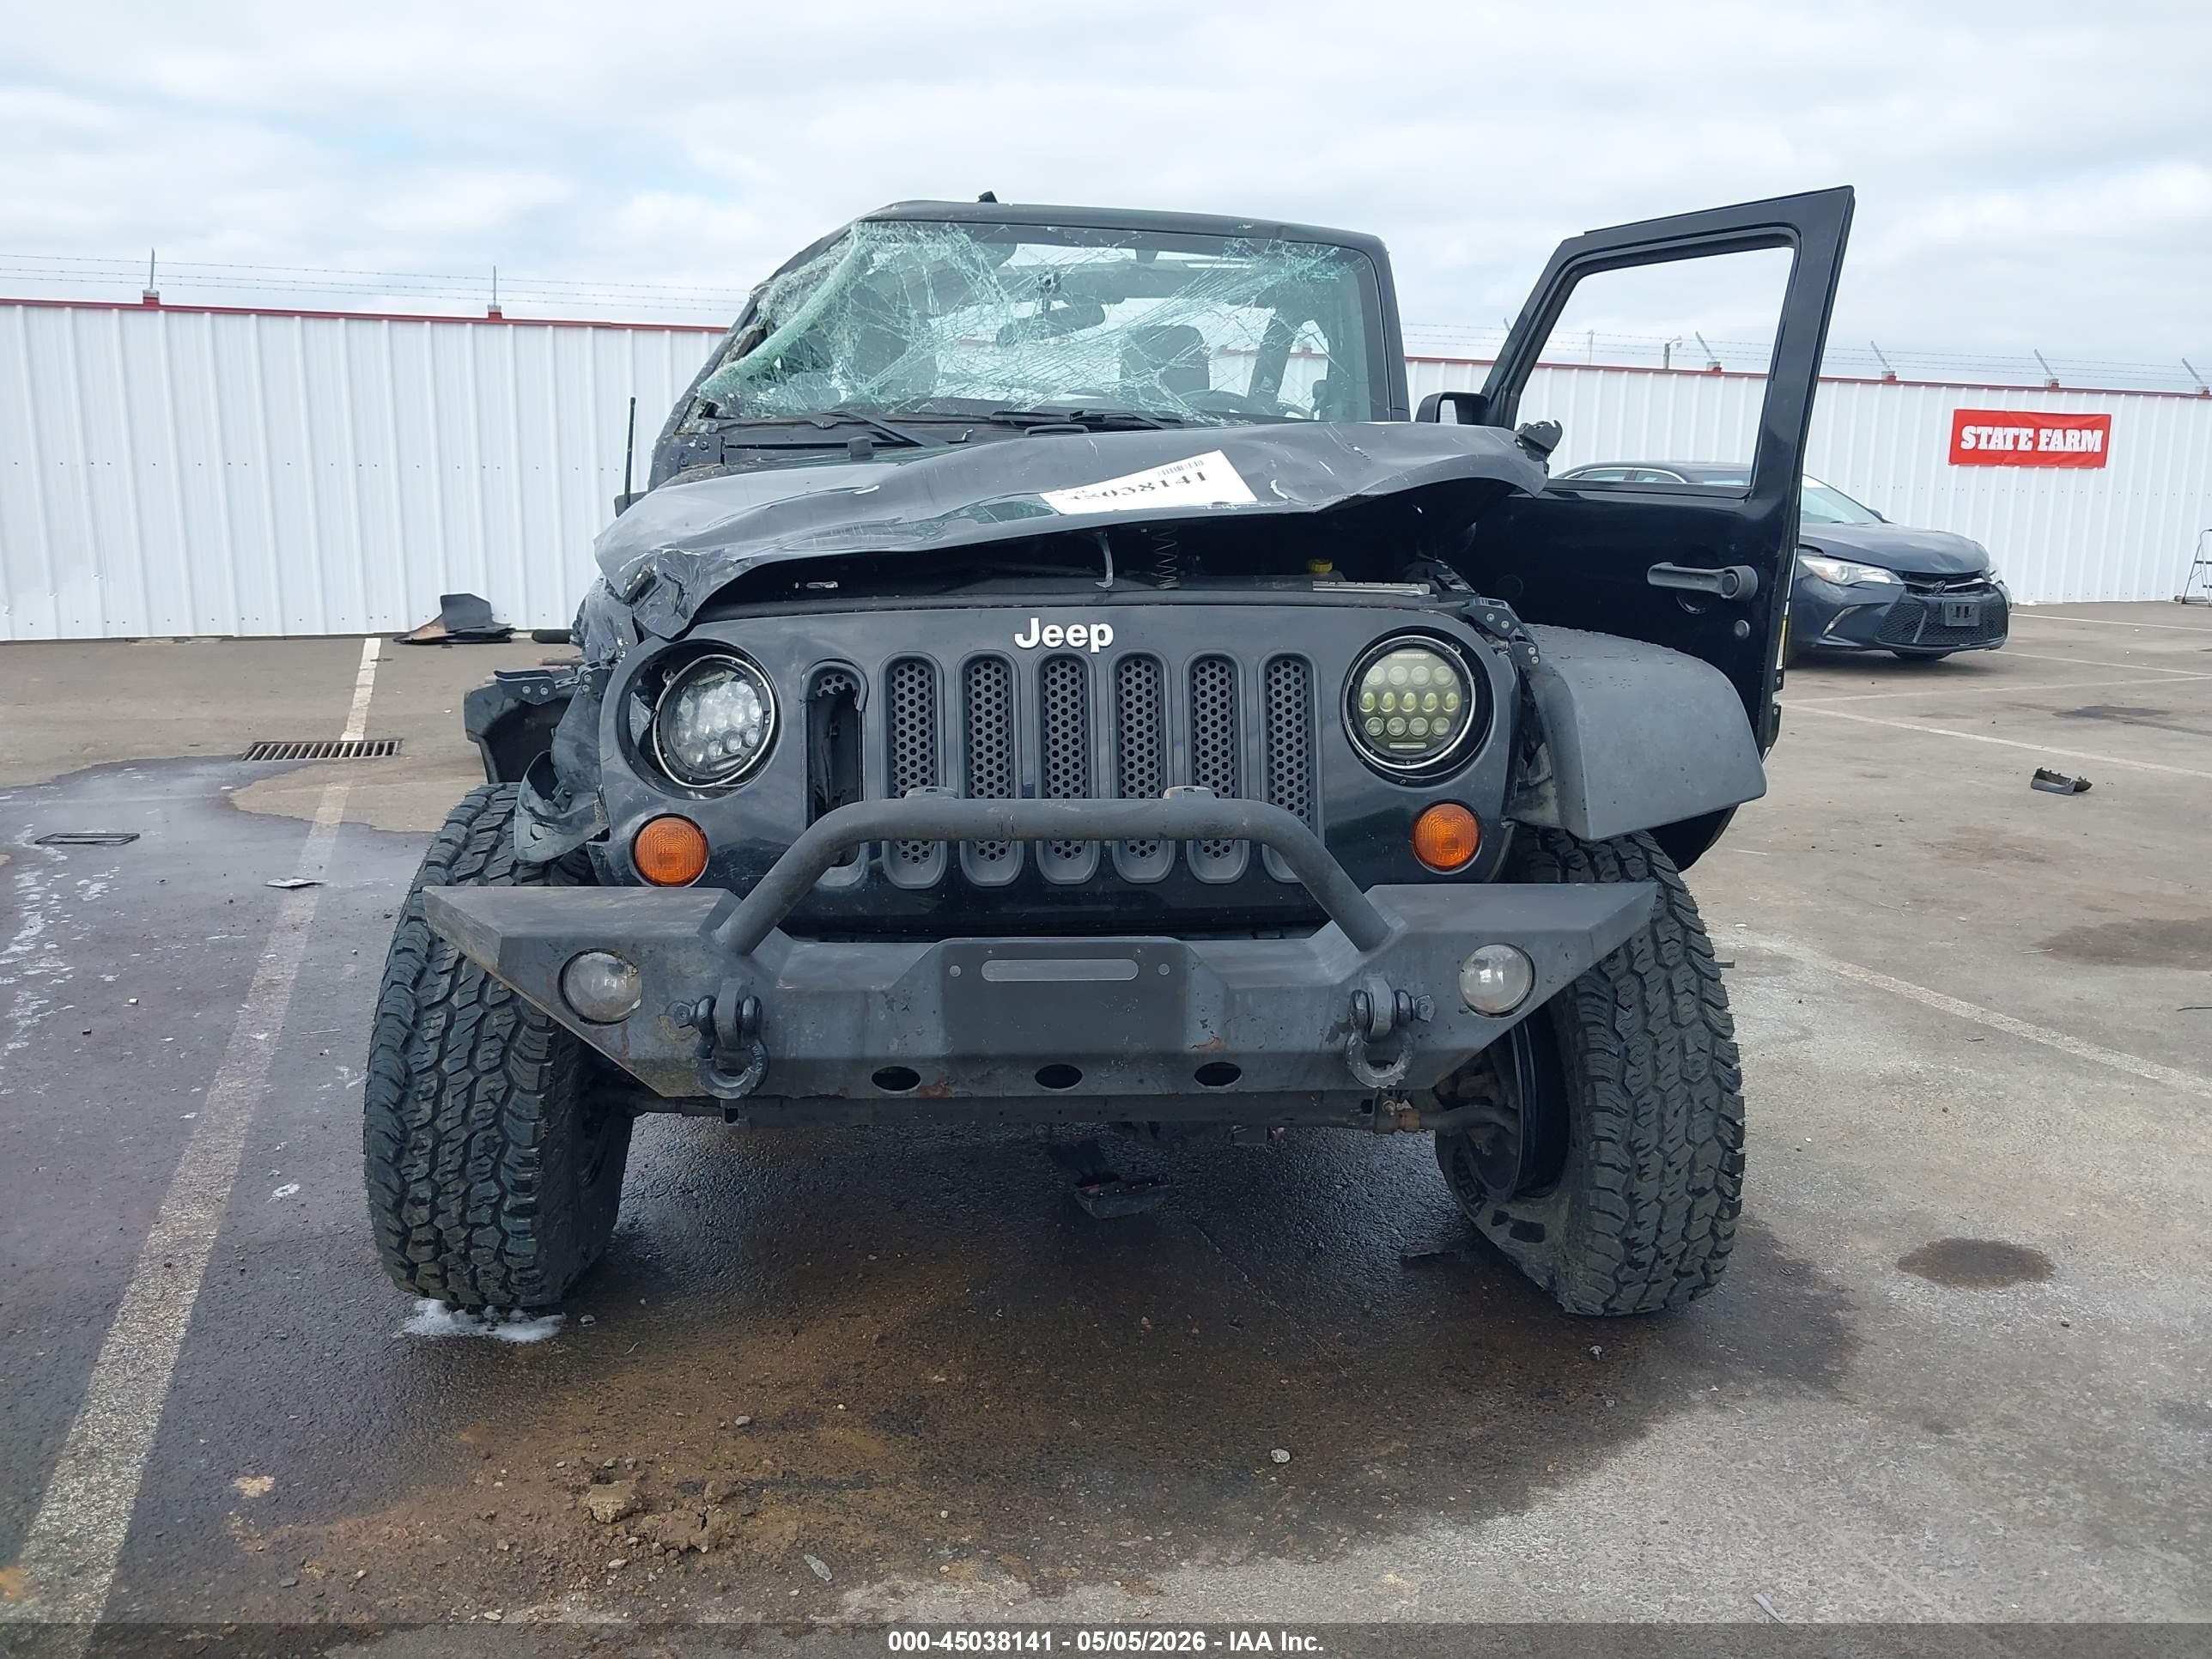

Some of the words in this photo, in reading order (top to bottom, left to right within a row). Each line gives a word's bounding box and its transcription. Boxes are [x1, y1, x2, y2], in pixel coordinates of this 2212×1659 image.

[1960, 425, 2034, 451] STATE
[2038, 428, 2104, 453] FARM
[1014, 617, 1114, 653] Jeep
